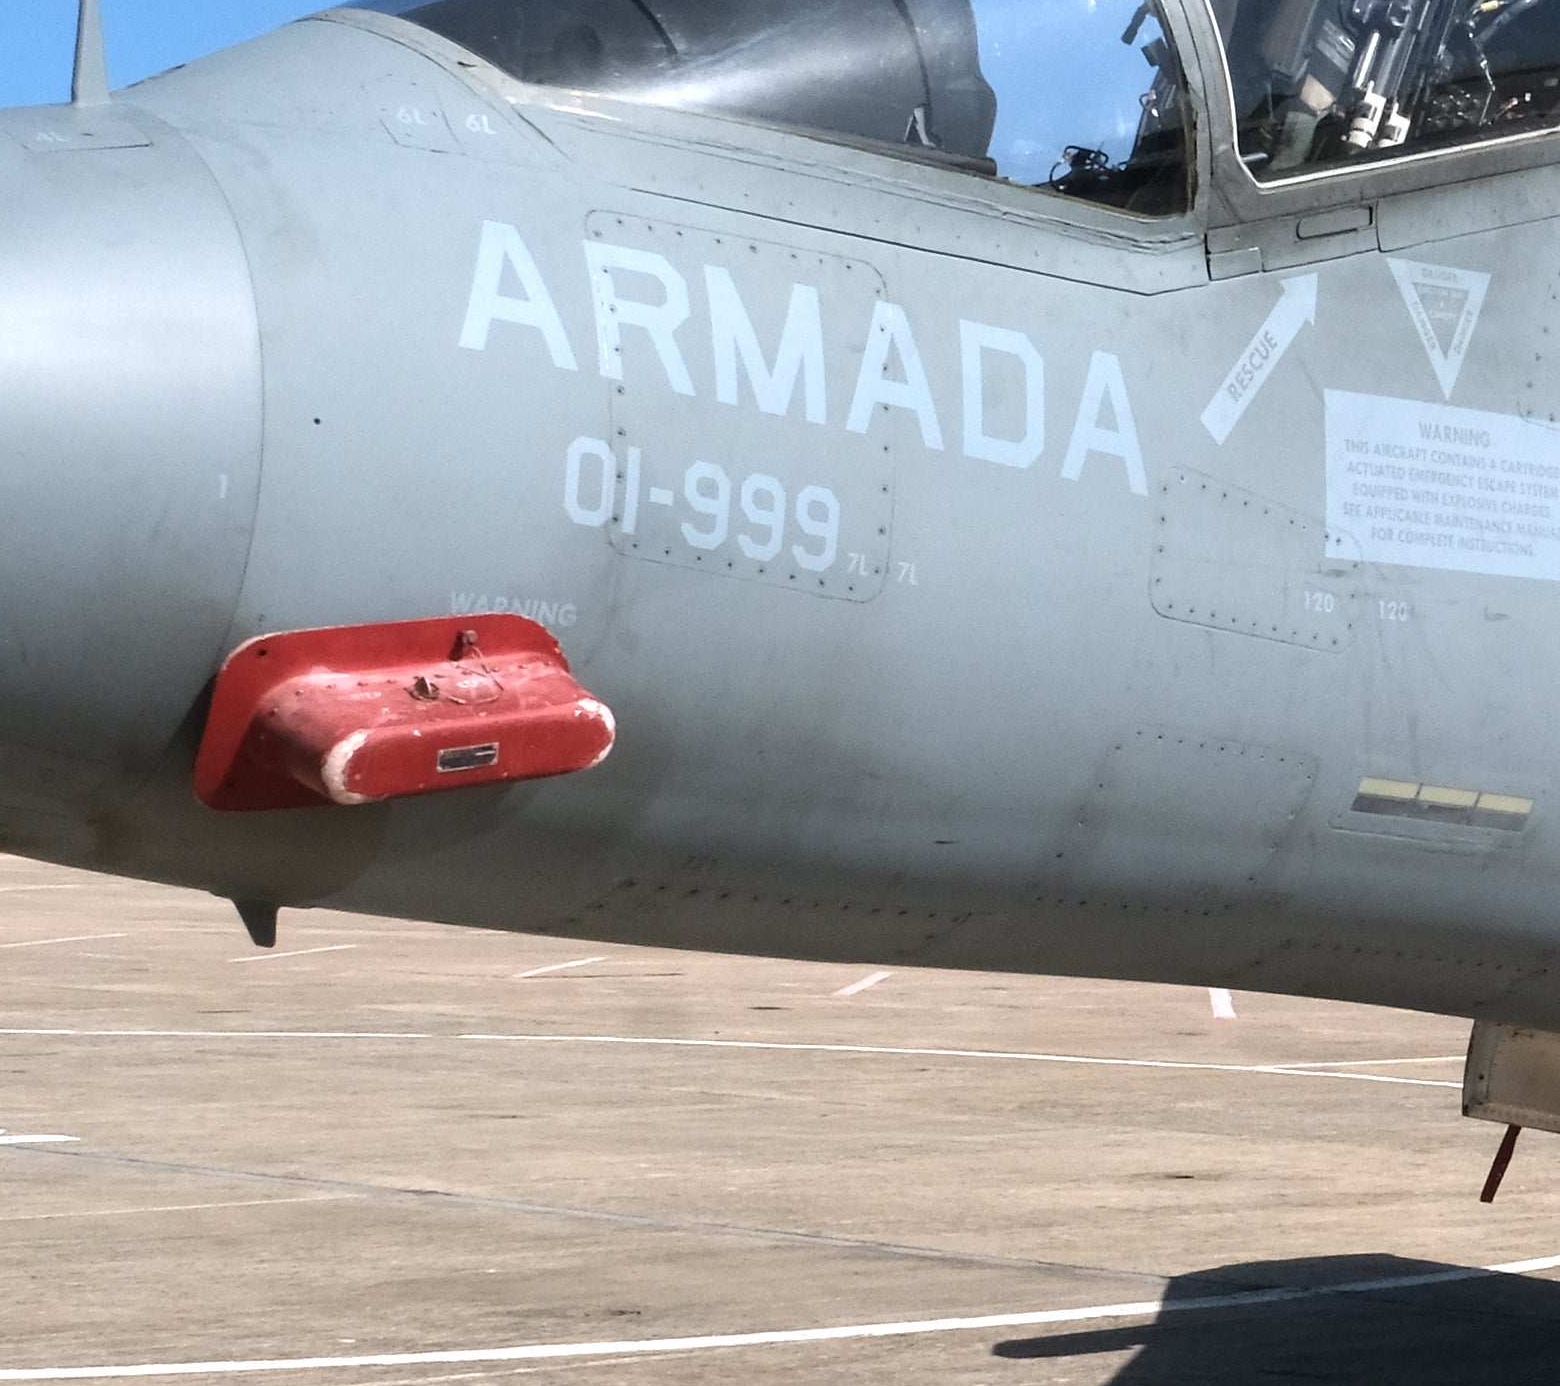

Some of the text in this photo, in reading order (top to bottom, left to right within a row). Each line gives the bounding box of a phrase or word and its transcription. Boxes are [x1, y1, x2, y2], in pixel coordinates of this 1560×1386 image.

[466, 114, 496, 135] 6L
[459, 220, 1149, 496] ARMADA
[1227, 331, 1278, 402] RESCUE
[1419, 421, 1490, 448] WARNING
[1344, 439, 1369, 454] THIS
[1373, 442, 1427, 462] AIRCRAFT
[1431, 449, 1486, 470] CONTAINS
[1347, 460, 1559, 500] ACTUATED EMERGENCY ESCAPE SYSTEM
[564, 435, 841, 572] 01-999
[1352, 482, 1408, 501] EQUIPPED
[1411, 489, 1439, 505] WITH
[1442, 492, 1498, 513] EXPLOSIVE
[1342, 501, 1361, 518] SEE
[1366, 504, 1432, 525] APPLICABLE
[1434, 512, 1513, 535] MAINTENANCE
[1371, 525, 1393, 542] FOR
[1397, 529, 1455, 549] COMPLETE
[846, 552, 870, 577] 7L
[897, 561, 920, 586] 7L
[449, 591, 577, 627] WARNING
[1304, 591, 1335, 613] 120
